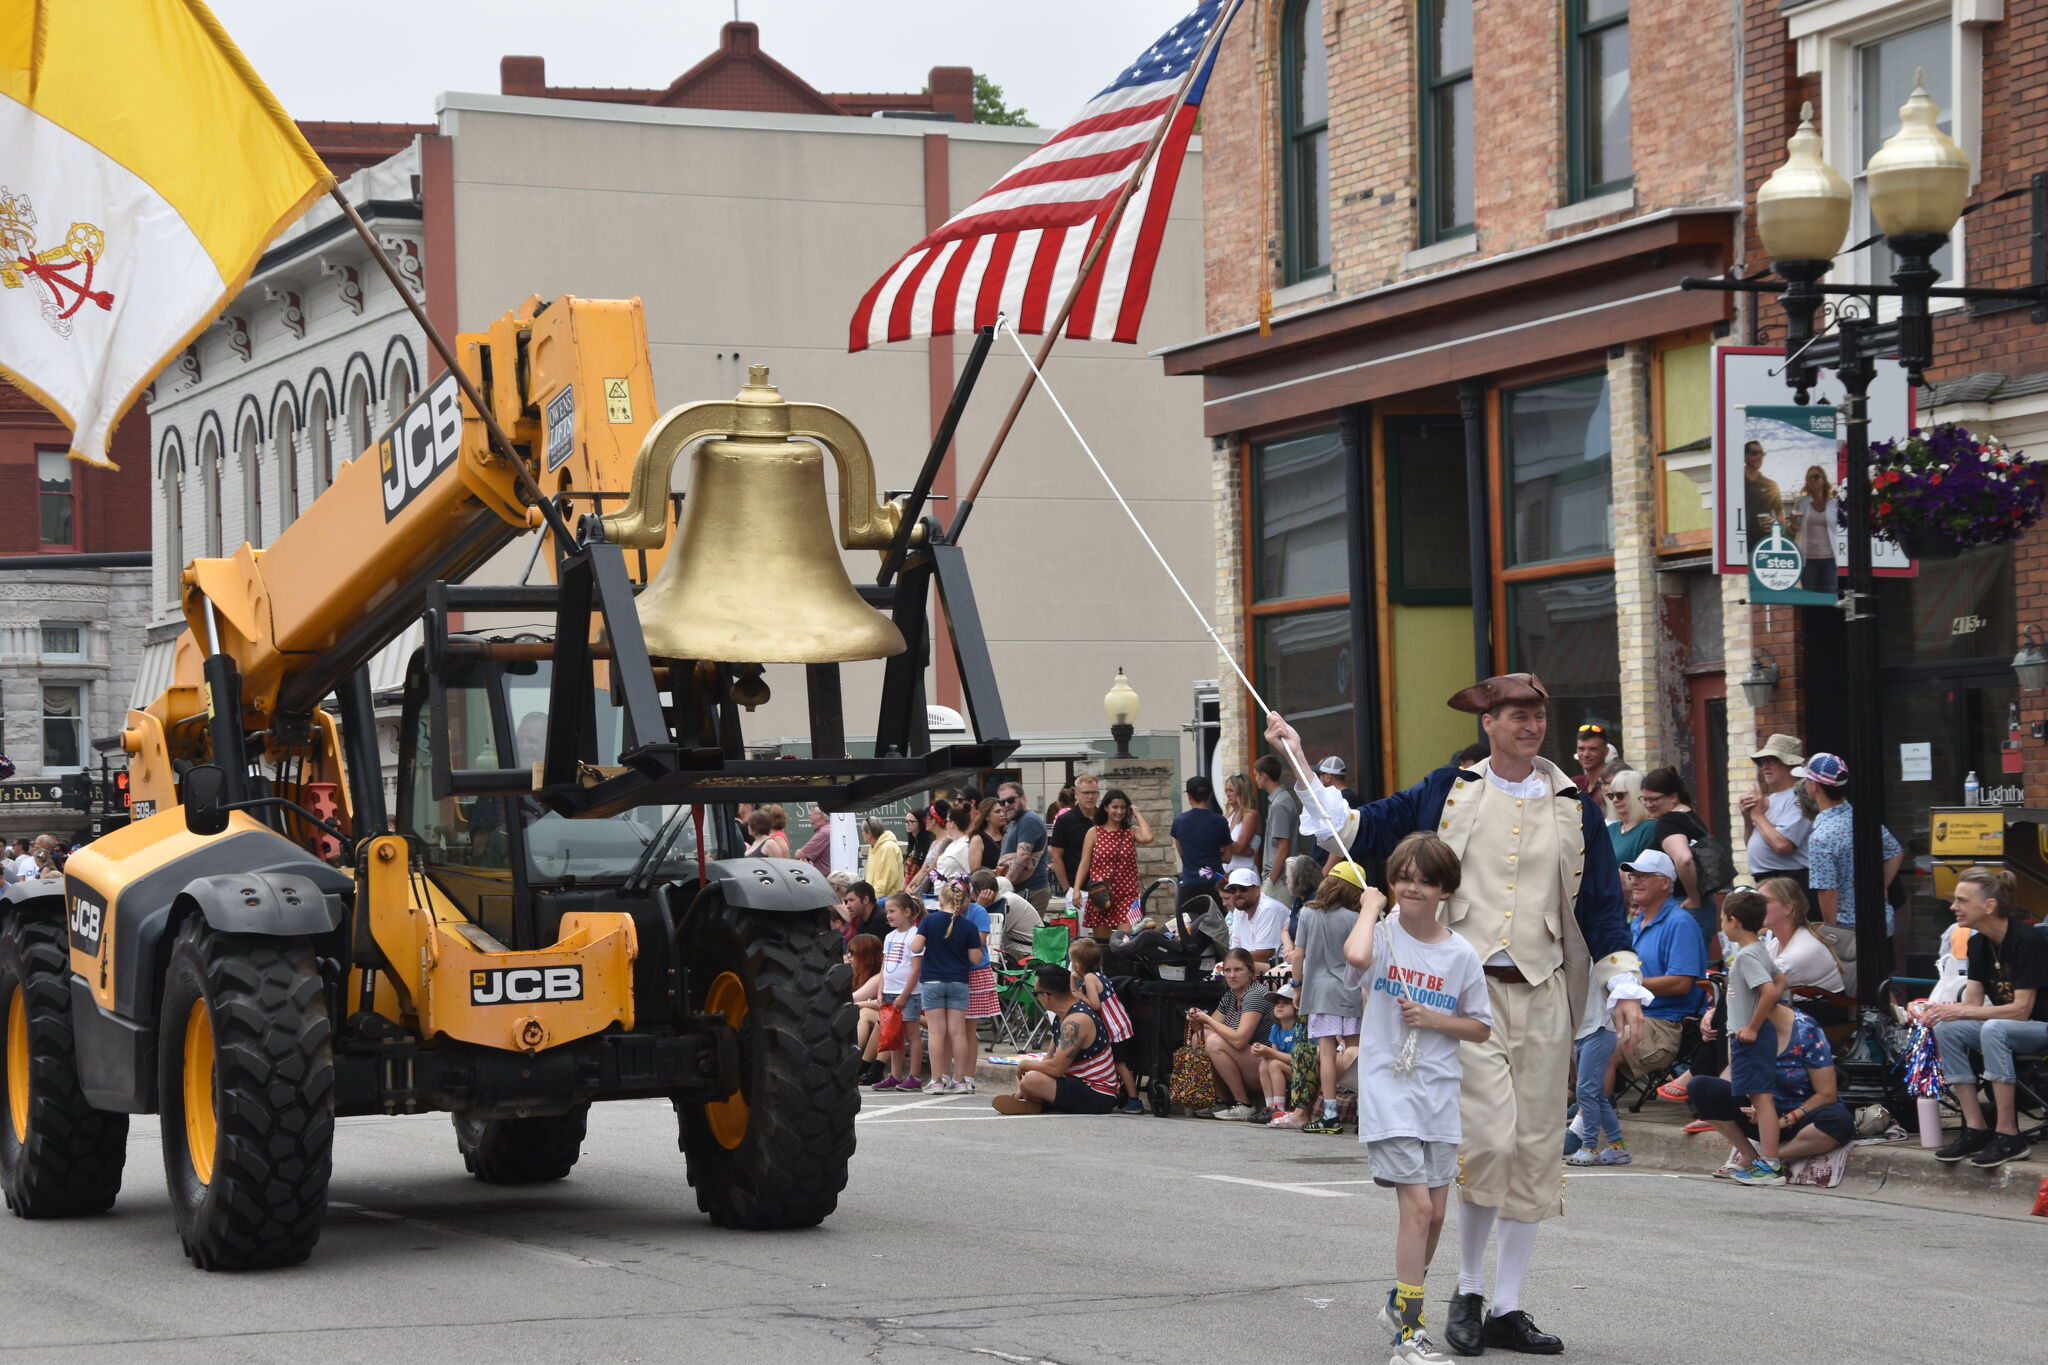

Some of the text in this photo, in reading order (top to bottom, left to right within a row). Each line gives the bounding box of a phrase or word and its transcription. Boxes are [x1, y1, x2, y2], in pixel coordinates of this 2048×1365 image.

[549, 393, 572, 426] OWENS
[383, 375, 463, 511] JCB
[1767, 557, 1795, 568] stee
[14, 786, 42, 800] Pub
[71, 898, 101, 942] JCB
[473, 967, 581, 1003] JCB
[1388, 965, 1444, 991] DON'T BE
